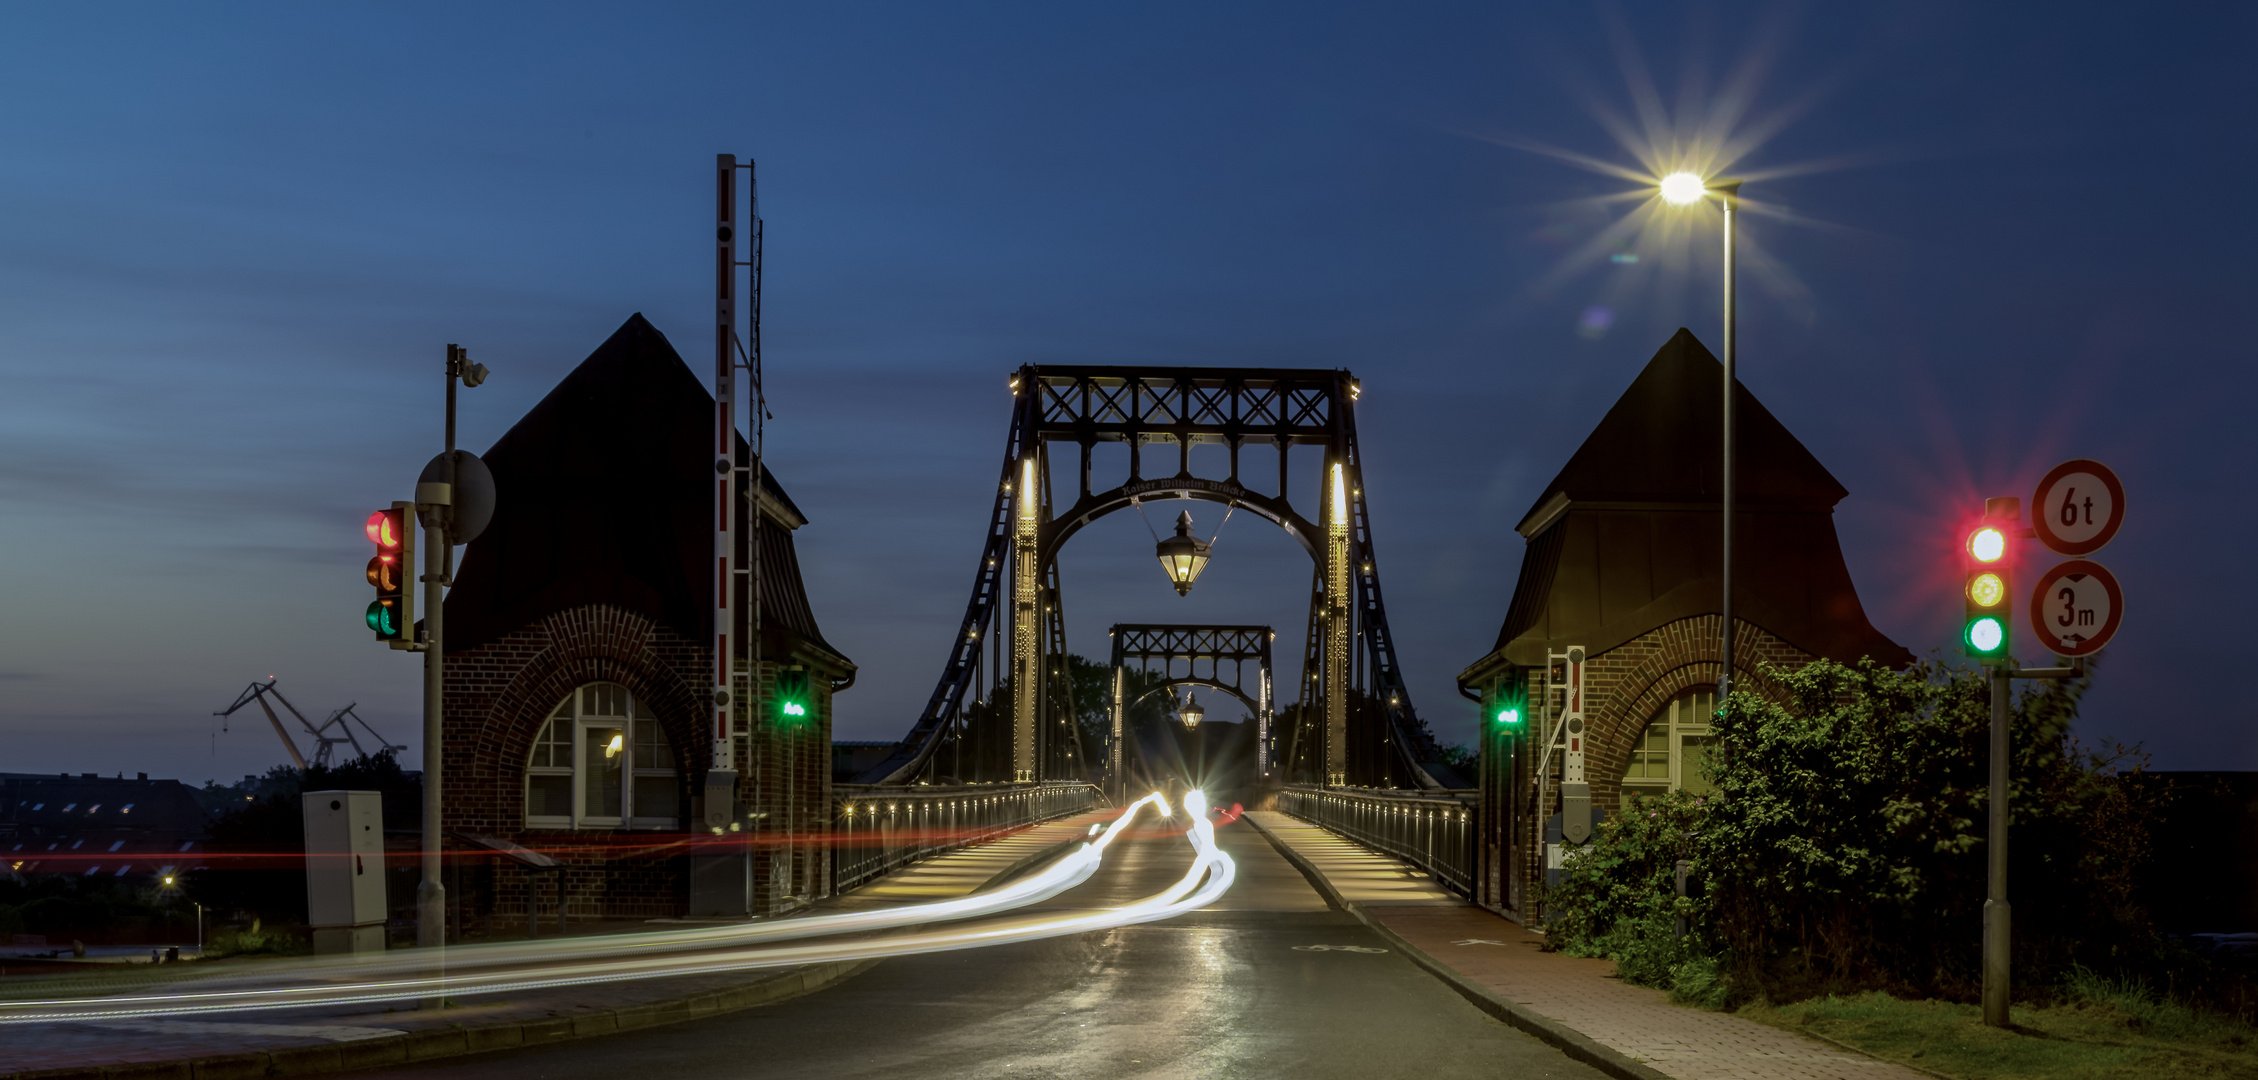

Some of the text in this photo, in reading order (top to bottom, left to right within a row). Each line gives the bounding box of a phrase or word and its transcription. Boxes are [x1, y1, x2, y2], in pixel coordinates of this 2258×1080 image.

[1122, 478, 1246, 498] Kaiser Wilhelm Brücke
